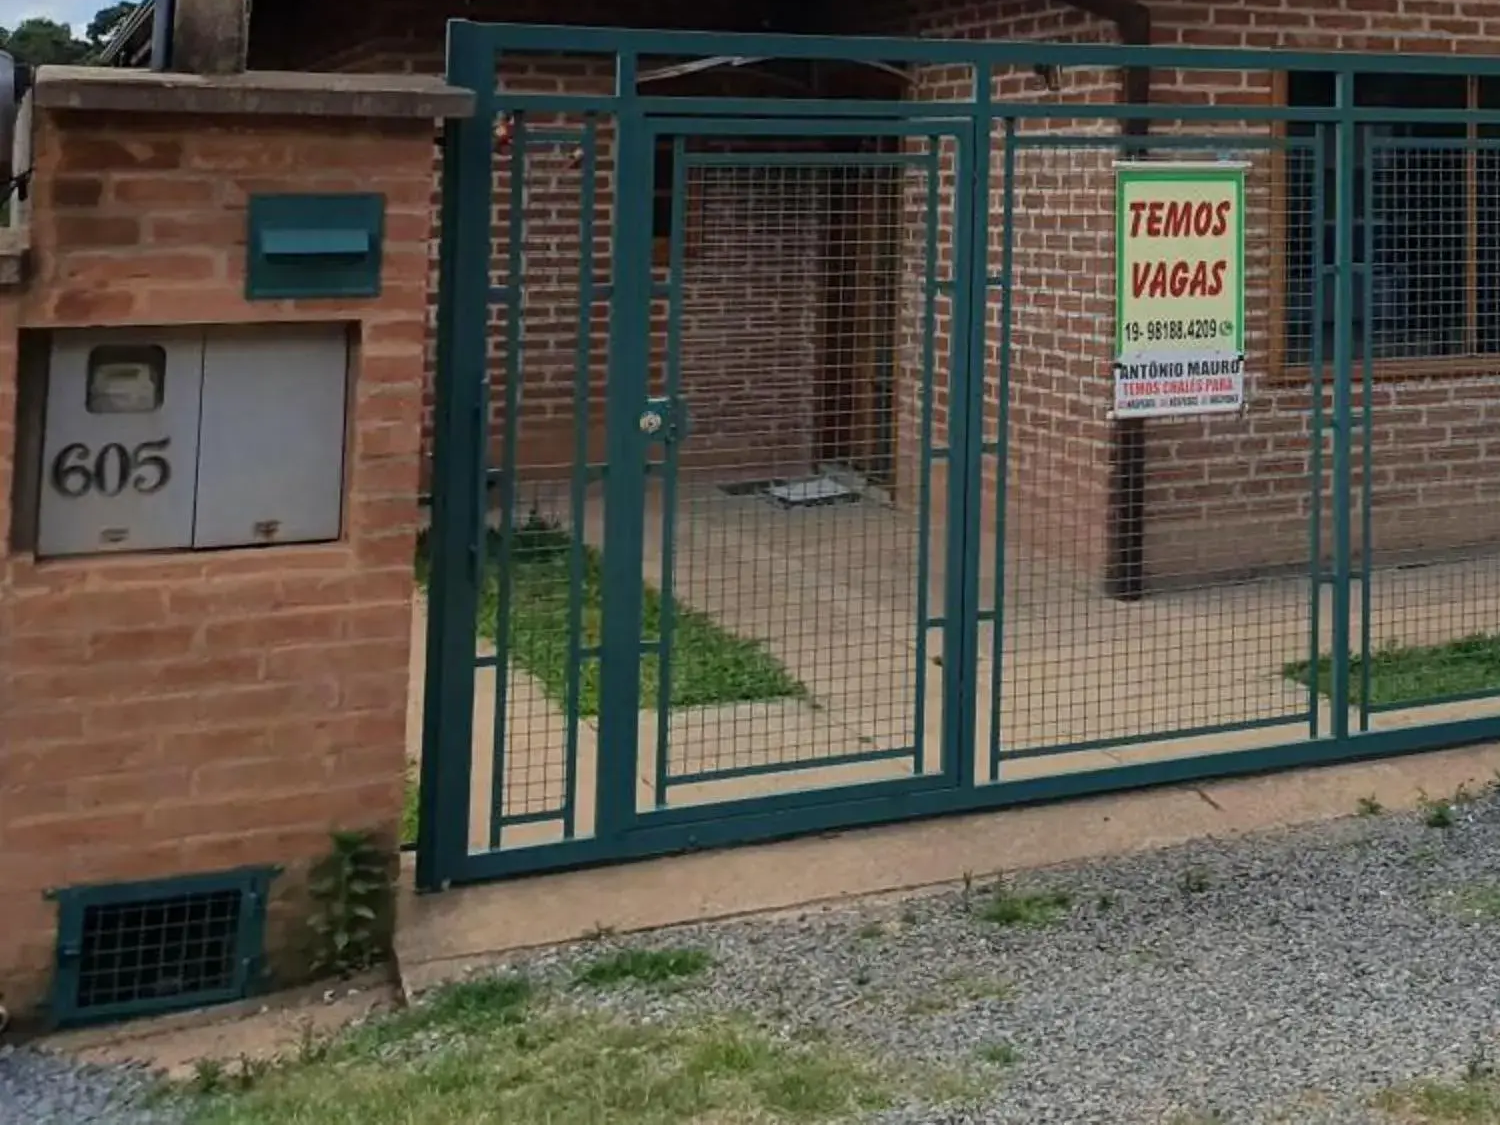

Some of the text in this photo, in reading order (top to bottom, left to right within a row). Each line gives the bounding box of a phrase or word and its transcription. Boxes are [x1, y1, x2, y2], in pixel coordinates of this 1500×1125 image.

[1128, 200, 1231, 238] TEMOS
[1132, 259, 1227, 298] VAGAS
[1187, 358, 1240, 376] MAURO
[52, 435, 173, 497] 605
